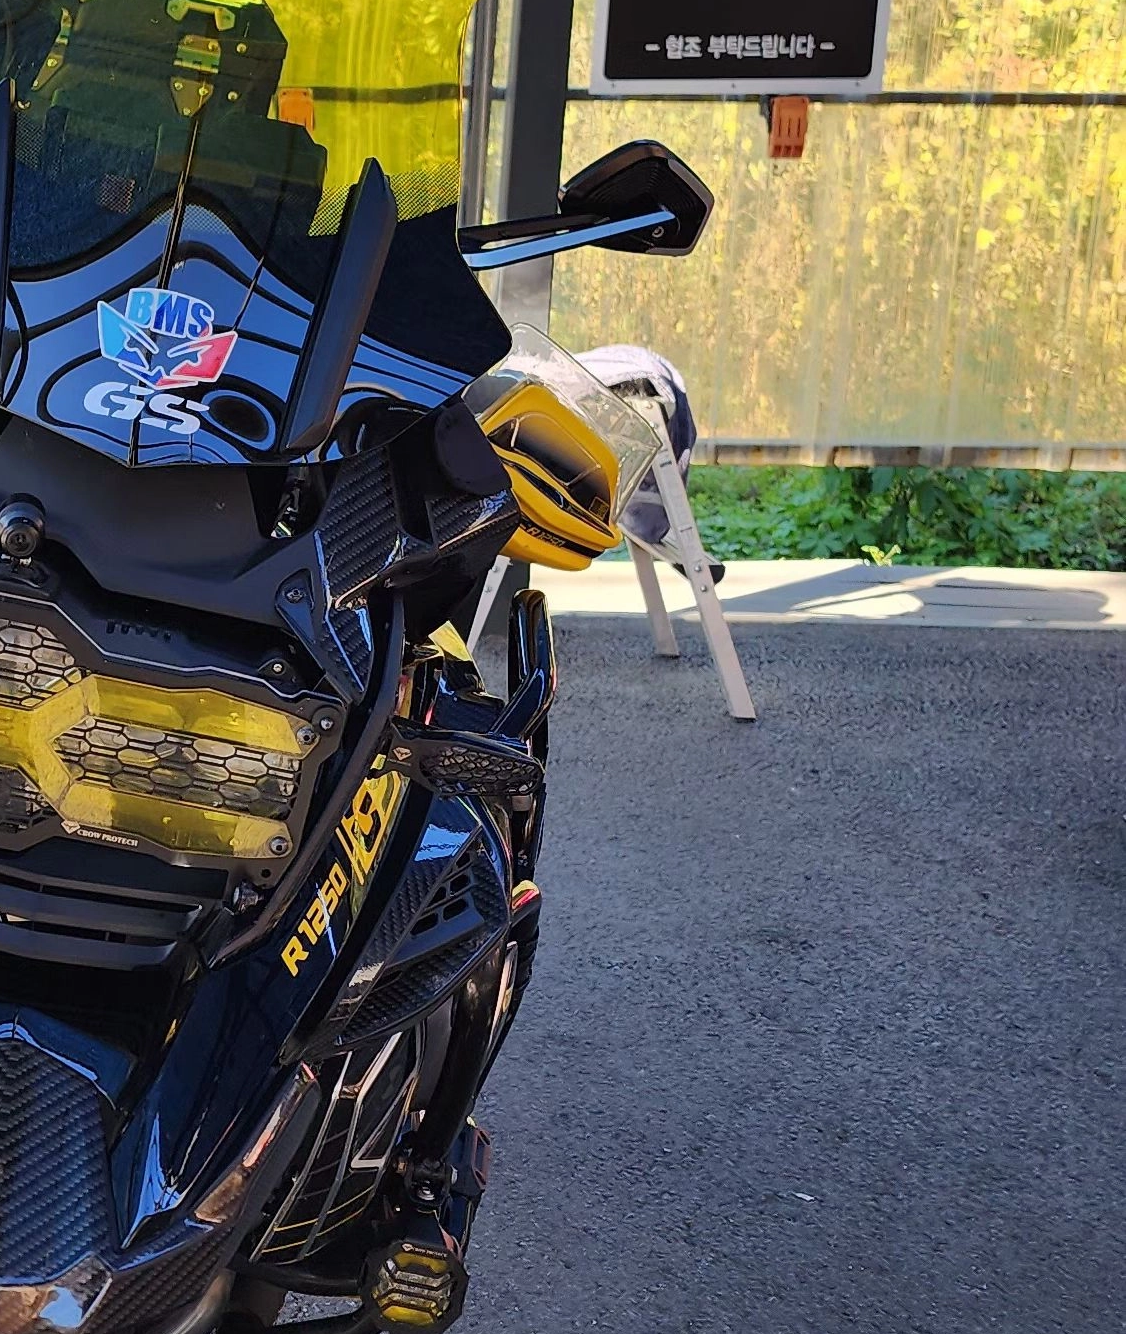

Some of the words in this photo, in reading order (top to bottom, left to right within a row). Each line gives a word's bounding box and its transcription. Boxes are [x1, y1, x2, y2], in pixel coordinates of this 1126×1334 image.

[666, 35, 702, 59] 협조
[708, 34, 815, 59] 부탁드립니다
[127, 288, 214, 340] BMS
[83, 380, 209, 435] GS
